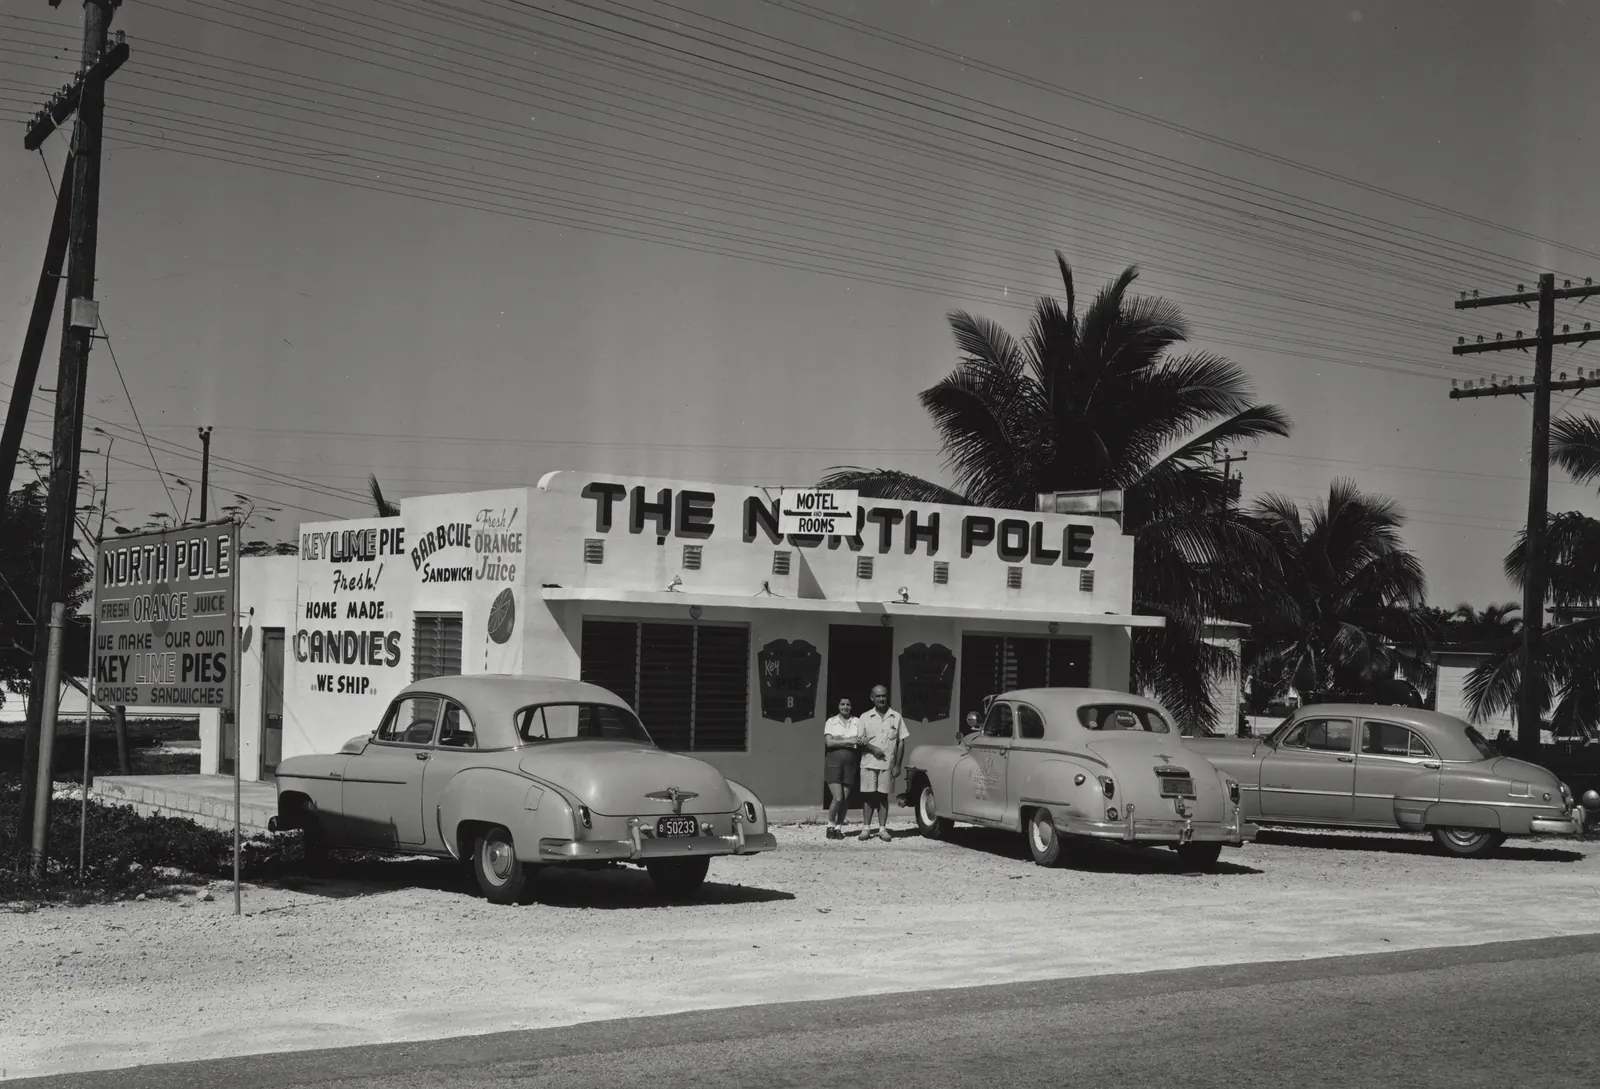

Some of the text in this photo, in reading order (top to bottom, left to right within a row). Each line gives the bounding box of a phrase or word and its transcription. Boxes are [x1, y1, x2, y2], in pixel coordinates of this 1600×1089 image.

[797, 493, 838, 510] MOTEL
[476, 507, 518, 534] Fresh!
[581, 481, 1094, 568] THE NTH POLE
[799, 518, 835, 533] ROOMS
[302, 527, 405, 563] KEY LIME PIE
[474, 533, 522, 553] ORANGE
[103, 534, 231, 588] NORTH POLE
[421, 562, 473, 583] SANDWICH
[475, 555, 516, 582] Juice
[333, 562, 384, 594] Fresh!
[101, 592, 225, 624] FRESH ORANGE JUICE
[306, 601, 385, 620] HOME MADE
[98, 629, 225, 650] WE MAKE OUR OWN
[292, 629, 402, 668] CANDIES
[97, 652, 227, 685] KEY LIME PIES
[97, 687, 224, 704] CANDIES SANDWICHES
[317, 674, 370, 694] WE SHIP
[667, 821, 694, 834] 50233
